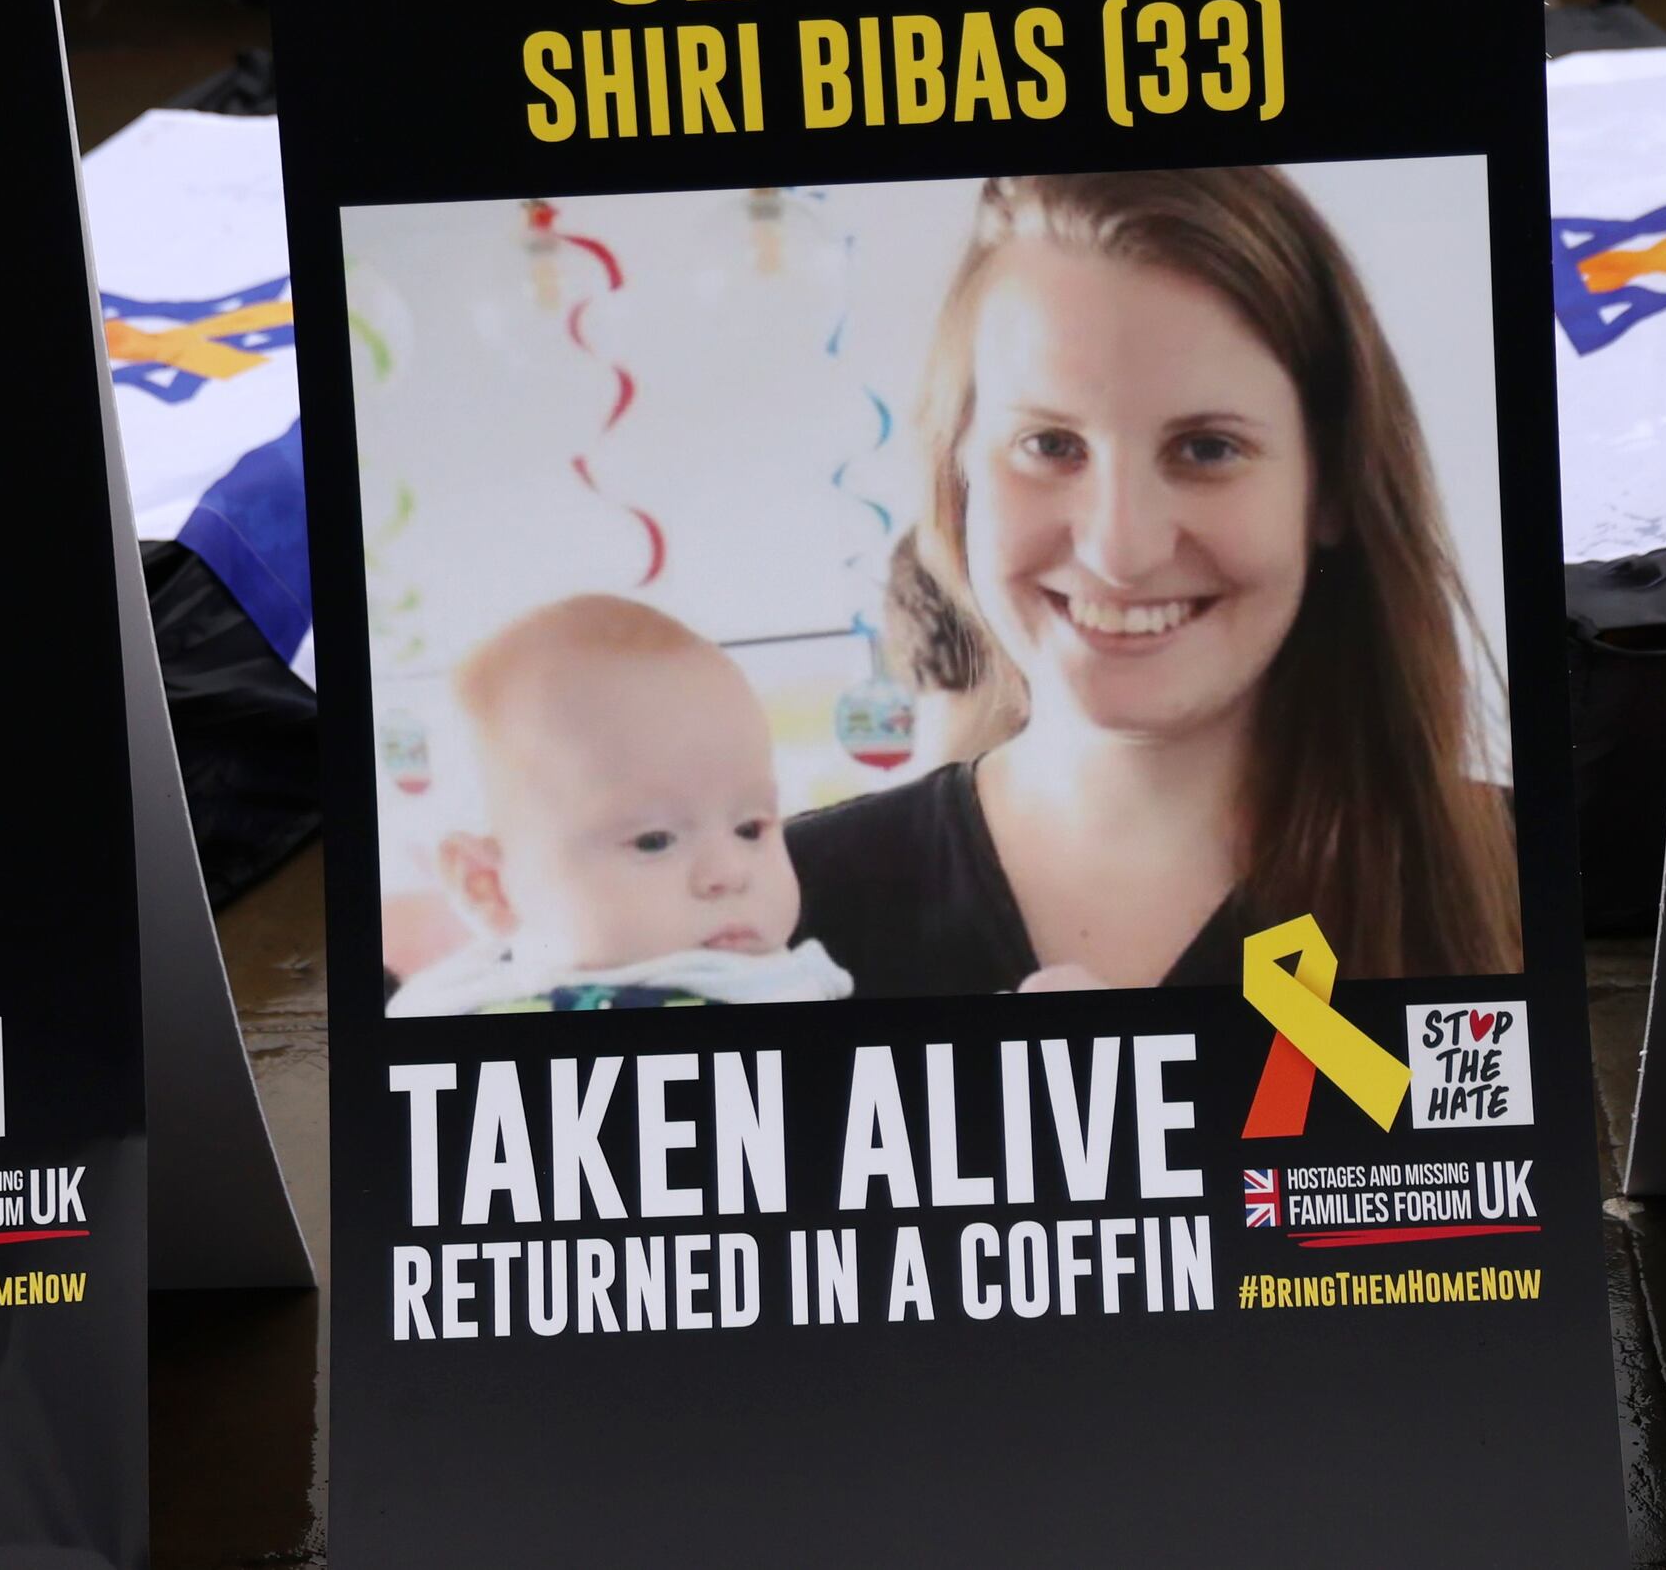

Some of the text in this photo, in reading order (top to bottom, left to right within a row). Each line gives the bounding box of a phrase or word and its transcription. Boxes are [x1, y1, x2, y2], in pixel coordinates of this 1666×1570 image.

[523, 22, 764, 143] SHIRI
[798, 7, 1067, 129] BIBAS
[1435, 1047, 1502, 1084] THE
[388, 1033, 1204, 1227] TAKEN ALIVE
[1427, 1083, 1510, 1122] HATE
[29, 1166, 87, 1225] UK
[1287, 1161, 1470, 1190] HOSTAGES AND MISSING
[1475, 1159, 1538, 1220] UK
[1288, 1189, 1472, 1226] FAMILIES FORUM
[393, 1215, 1215, 1341] RETURNED IN A COFFIN
